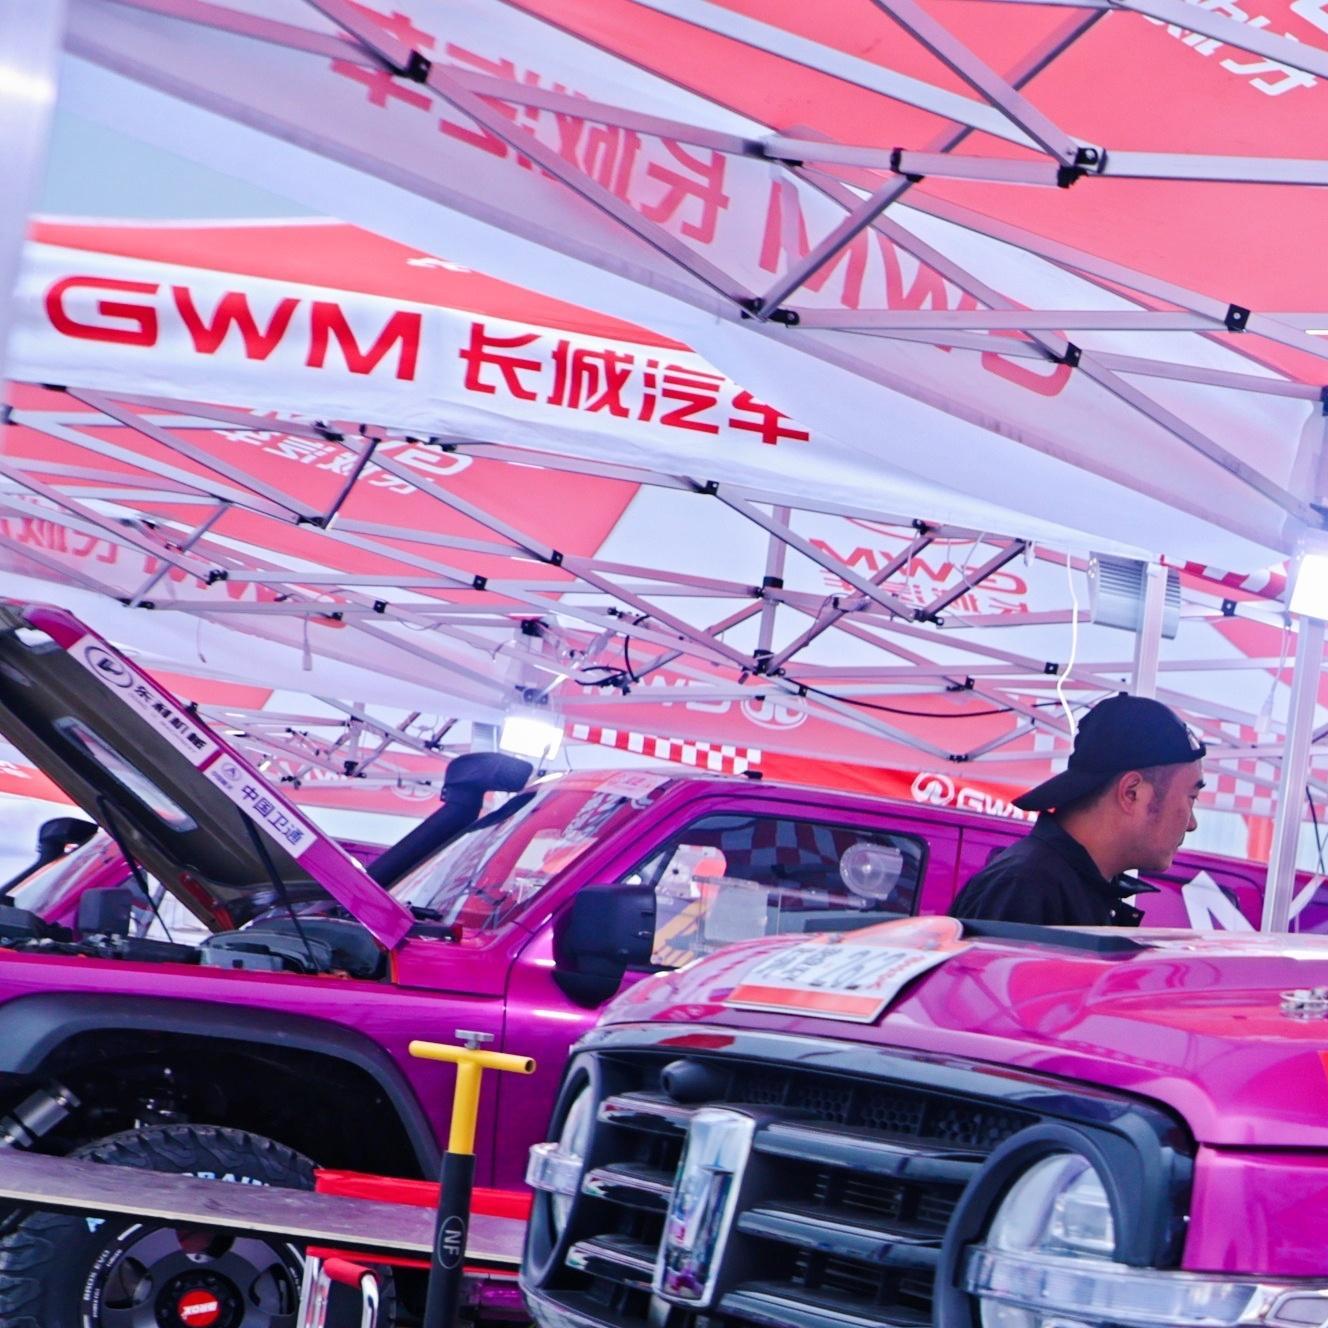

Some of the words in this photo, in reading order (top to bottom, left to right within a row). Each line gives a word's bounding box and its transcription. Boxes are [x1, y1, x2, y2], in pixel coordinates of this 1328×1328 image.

[44, 274, 422, 382] GWM
[459, 322, 810, 446] 长城汽车
[442, 1227, 463, 1261] NF
